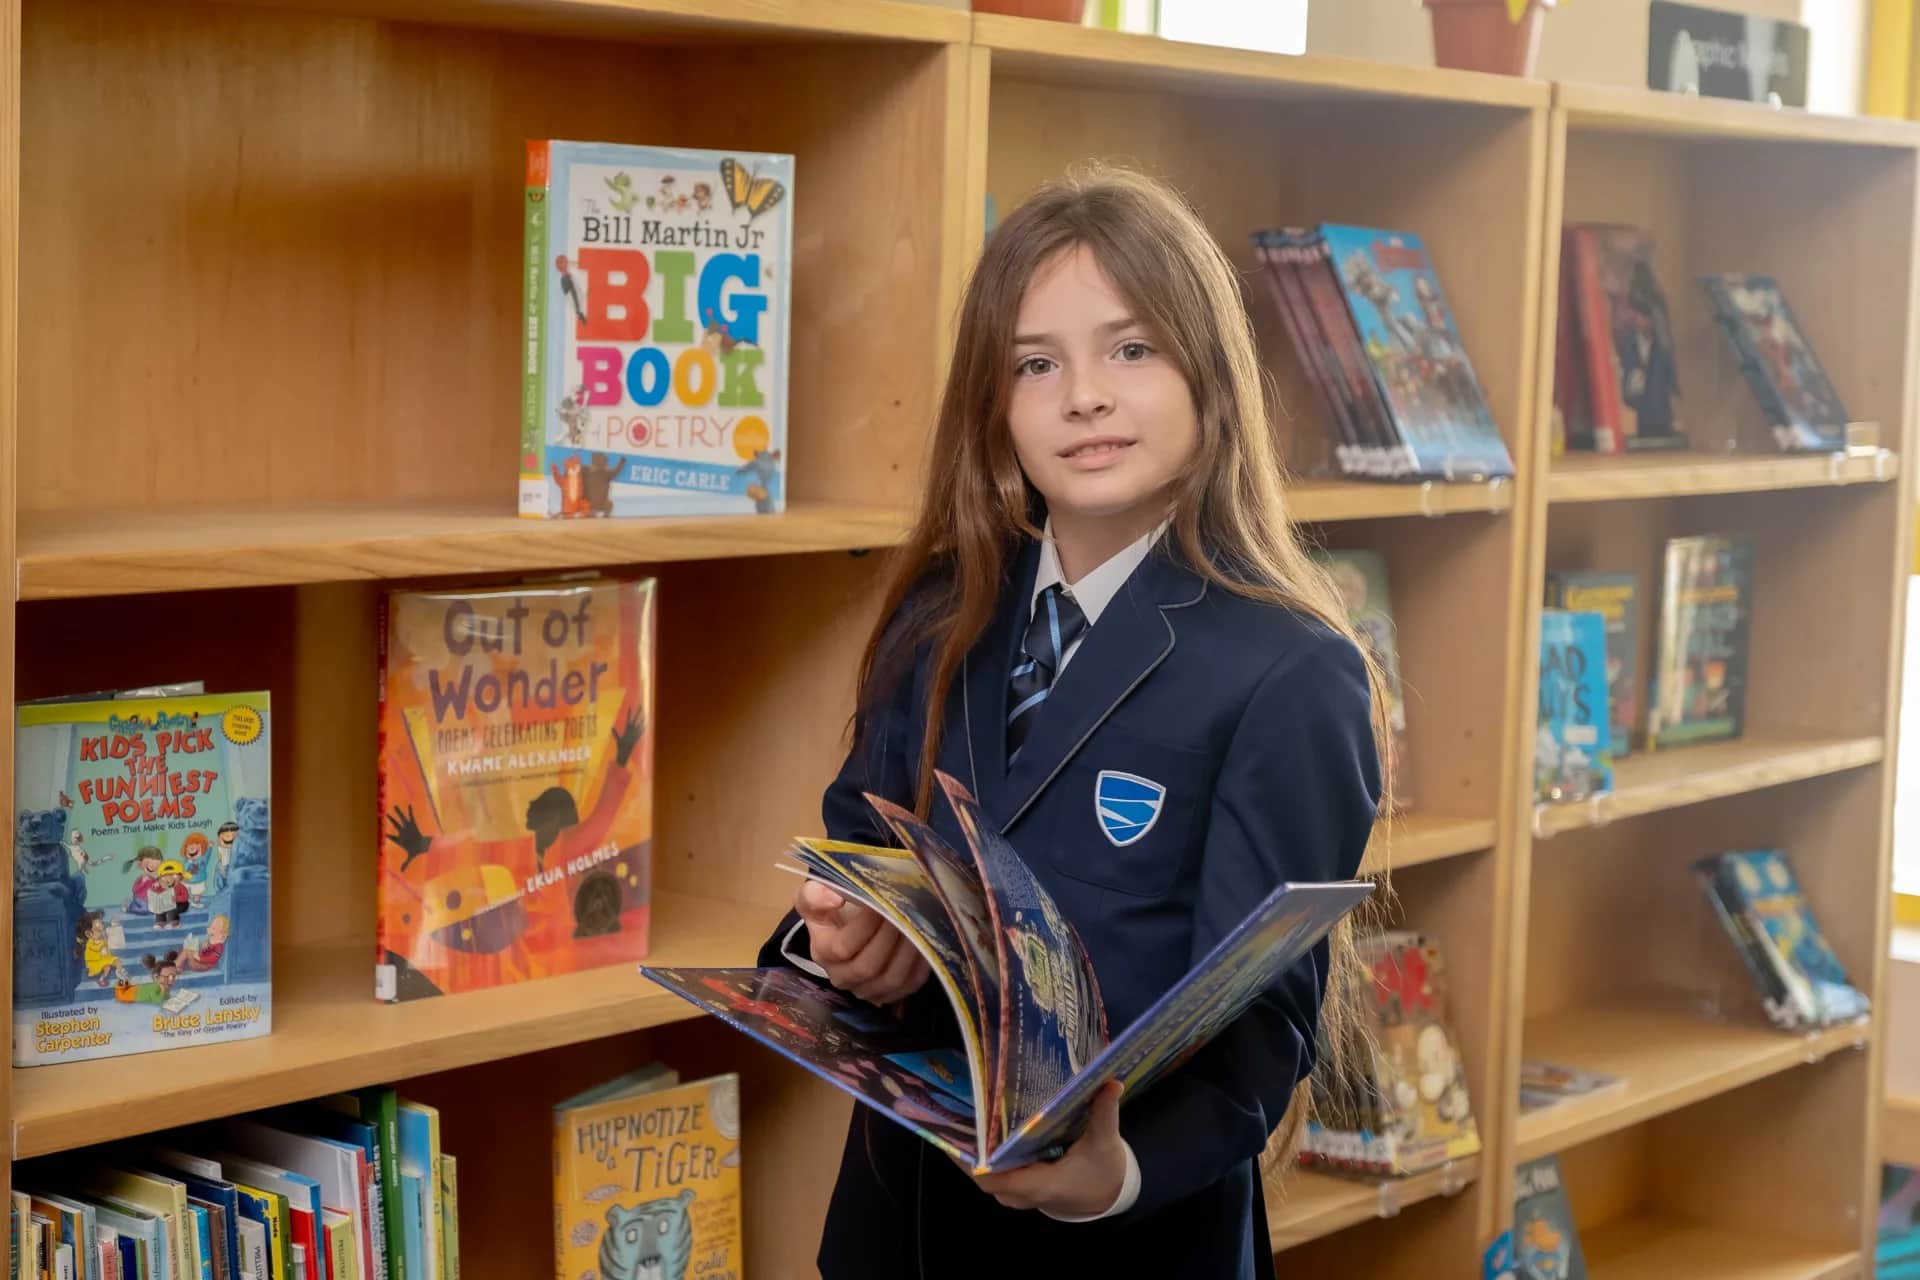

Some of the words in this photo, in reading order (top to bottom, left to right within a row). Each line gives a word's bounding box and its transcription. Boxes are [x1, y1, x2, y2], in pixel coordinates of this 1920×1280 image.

[583, 215, 632, 244] Bill
[641, 219, 729, 250] Martin
[735, 223, 764, 249] Jr
[575, 247, 768, 346] BIG
[575, 345, 765, 408] BOOK
[606, 415, 734, 449] POETRY
[629, 464, 671, 486] ERIC
[674, 470, 731, 491] CARLE
[444, 597, 529, 656] Out
[543, 594, 592, 647] of
[1540, 645, 1588, 681] AD
[429, 658, 608, 724] Wonder
[80, 733, 147, 762] KIDS
[156, 727, 215, 756] PICK
[448, 754, 502, 776] KWAME
[507, 744, 591, 769] ALEXANDER
[124, 755, 168, 776] THE
[78, 769, 218, 804] FUNNIEST
[102, 795, 196, 825] POEMS
[91, 827, 119, 836] Poems
[123, 825, 141, 833] That
[143, 824, 165, 832] Make
[167, 821, 186, 830] Kids
[188, 819, 213, 831] Laugh
[526, 866, 565, 893] EKUA
[567, 841, 619, 876] HOLMES
[41, 1009, 85, 1020] Illustrated
[87, 1006, 99, 1018] by
[219, 996, 244, 1006] Edited
[247, 994, 258, 1006] by
[35, 1016, 100, 1040] Stephen
[153, 1013, 201, 1032] Bruce
[206, 1004, 261, 1025] Lansky
[36, 1032, 113, 1054] Carpenter
